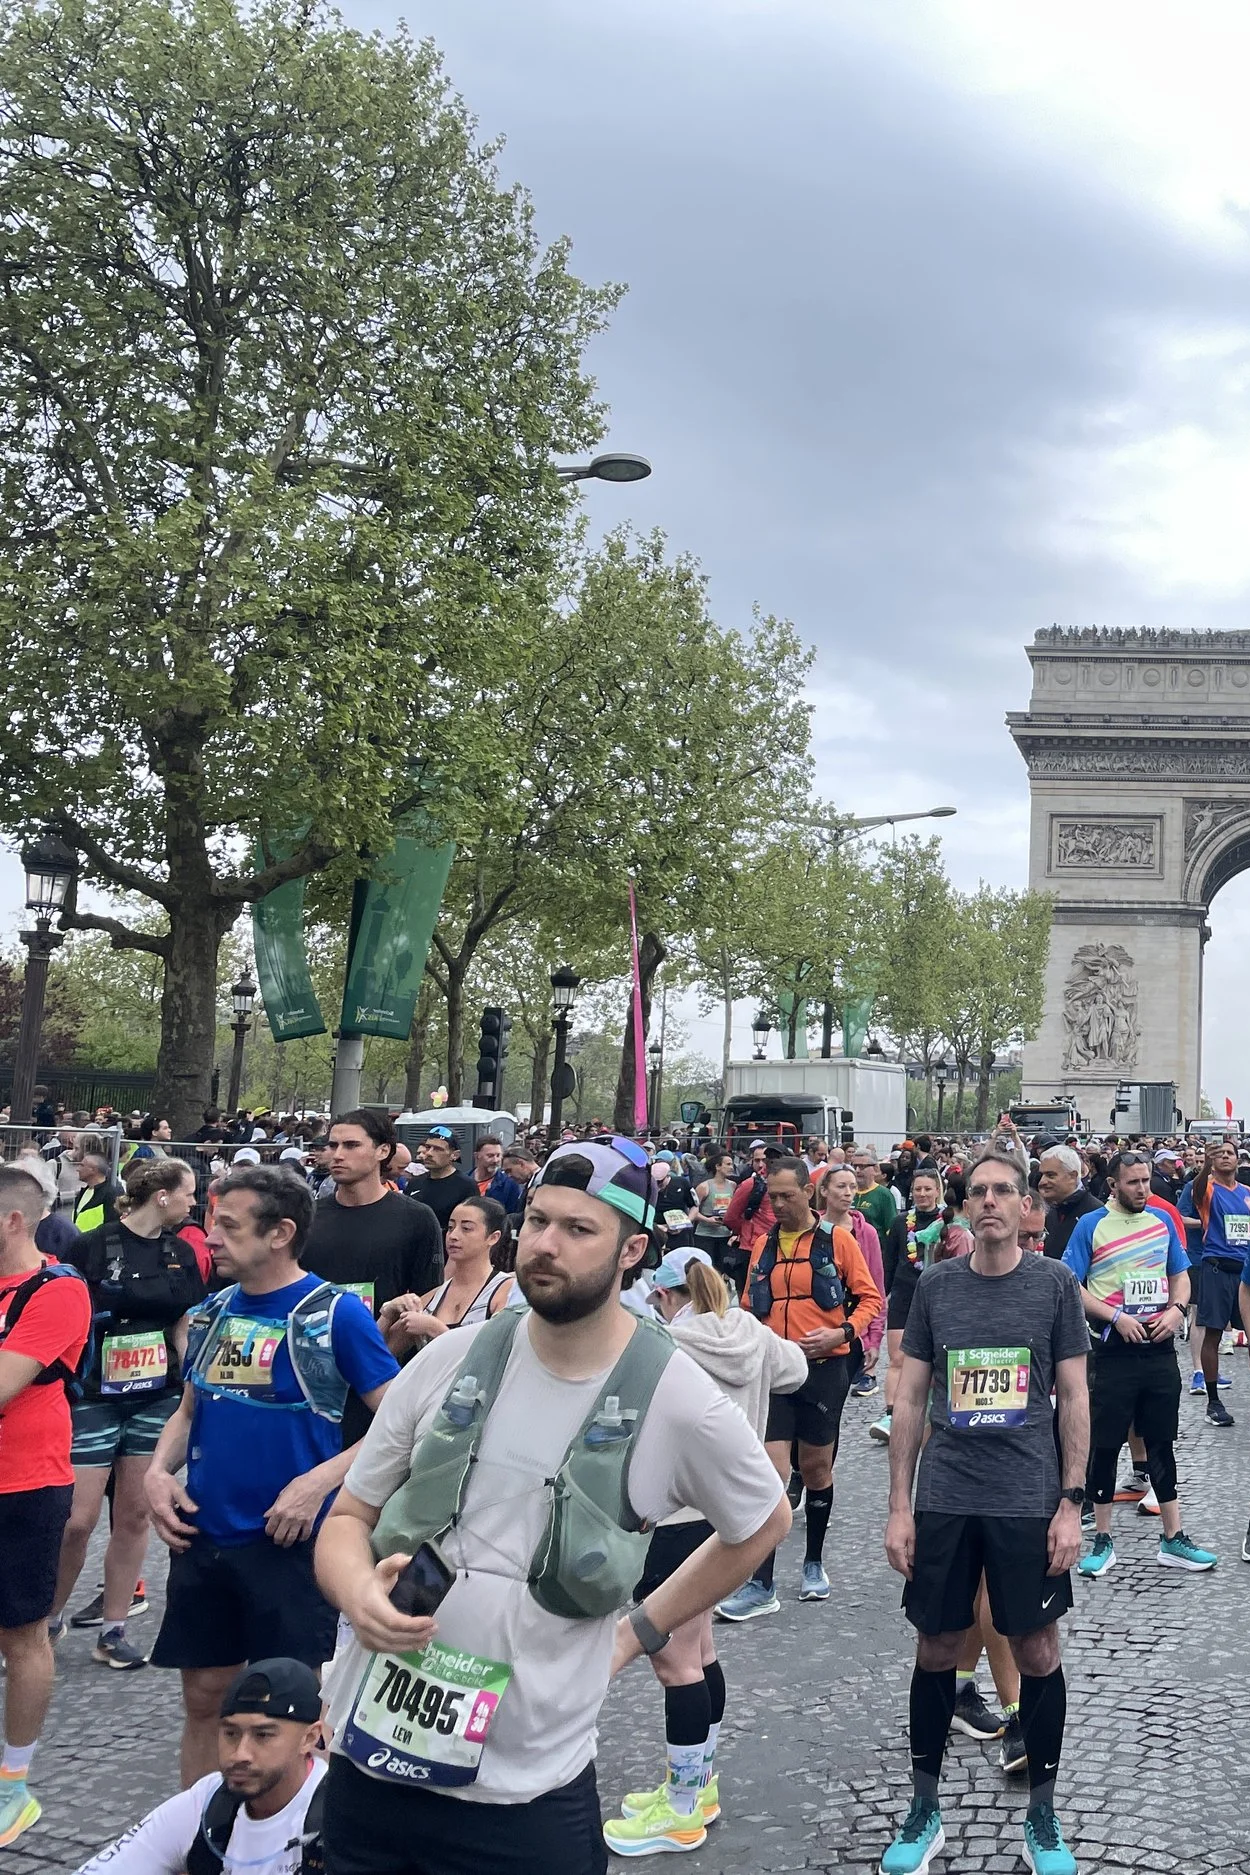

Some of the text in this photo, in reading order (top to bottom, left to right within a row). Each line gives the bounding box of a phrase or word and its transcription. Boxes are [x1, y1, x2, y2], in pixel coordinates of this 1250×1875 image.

[112, 1347, 156, 1370] 78472
[969, 1349, 1020, 1360] Schneider
[960, 1368, 1011, 1395] 71739
[373, 1659, 466, 1736] 70495
[391, 1724, 414, 1746] LEVI
[386, 1757, 432, 1780] asics
